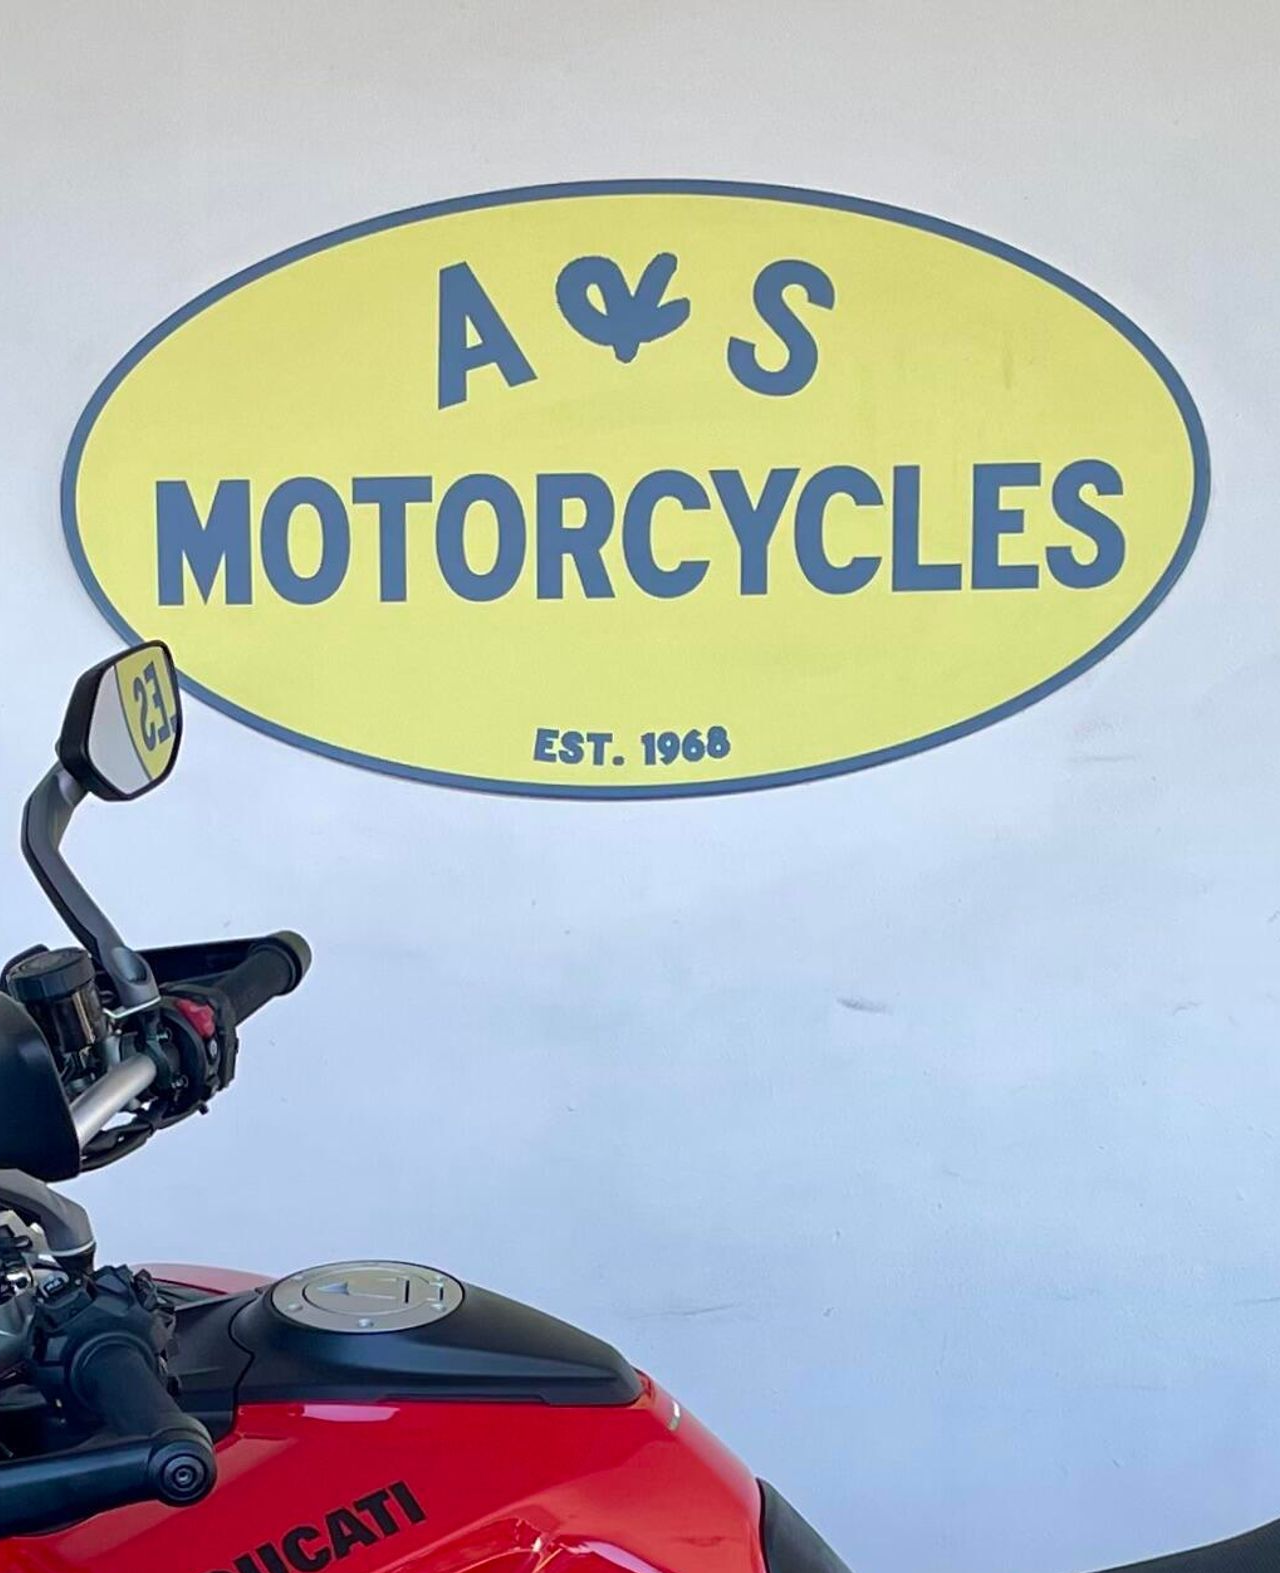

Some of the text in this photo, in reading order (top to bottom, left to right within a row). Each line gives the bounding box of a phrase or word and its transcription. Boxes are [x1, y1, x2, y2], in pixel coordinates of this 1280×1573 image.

[437, 262, 536, 409] A
[726, 260, 835, 397] S
[154, 458, 1127, 607] MOTORCYCLES
[533, 724, 731, 766] EST. 1968
